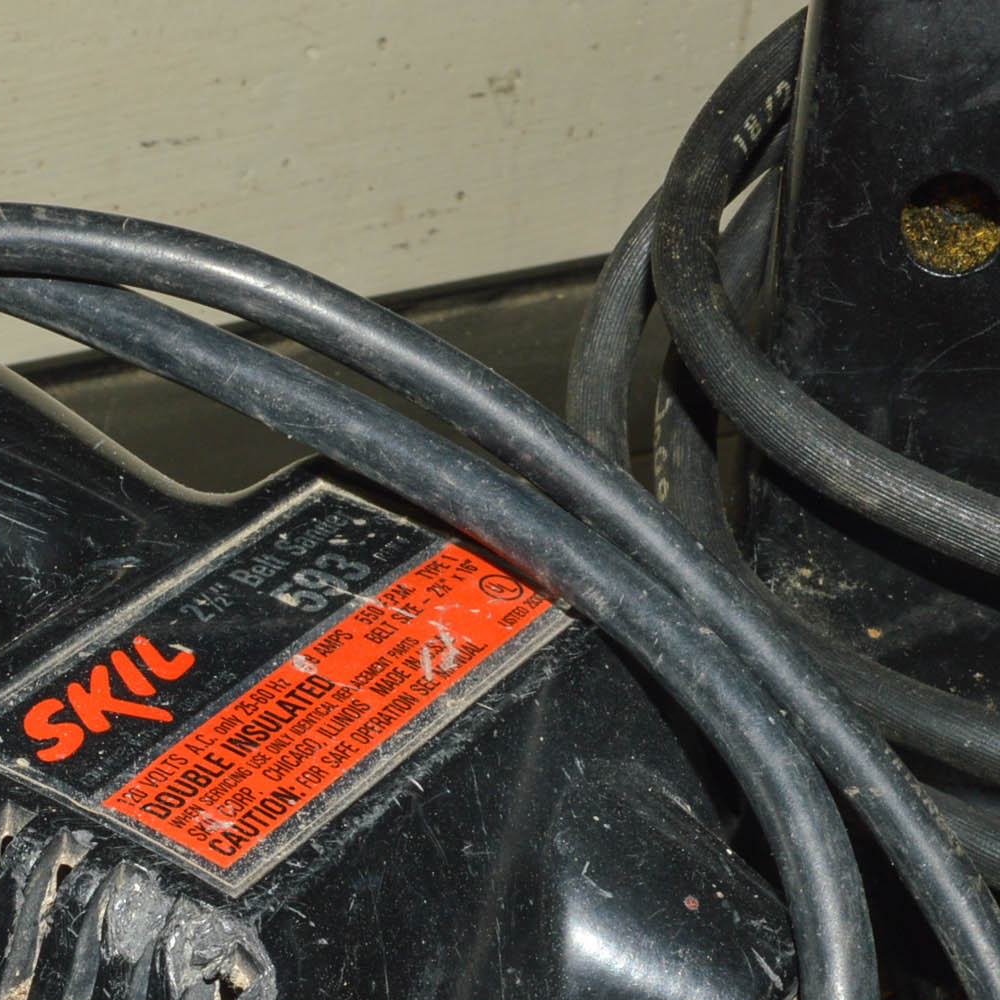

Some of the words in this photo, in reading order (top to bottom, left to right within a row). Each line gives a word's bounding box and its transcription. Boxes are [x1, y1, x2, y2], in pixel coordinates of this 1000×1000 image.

[229, 553, 290, 588] Belt
[273, 510, 350, 556] Sander
[270, 552, 370, 612] 593
[23, 635, 196, 762] SKIL
[114, 785, 150, 808] 120
[136, 752, 190, 789] VOLTS
[182, 730, 219, 755] A.C.
[209, 712, 246, 737] only
[233, 687, 276, 717] 25-60
[265, 675, 292, 693] Hz
[311, 627, 355, 658] AMPS
[353, 603, 387, 626] 550
[413, 556, 451, 582] TYPE
[363, 619, 401, 645] BELT
[138, 751, 236, 821] DOUBLE
[219, 672, 337, 758] INSULATED
[167, 802, 206, 829] WHEN
[197, 765, 254, 807] SERVICING
[245, 751, 273, 769] USE
[264, 732, 297, 755] ONLY
[288, 698, 340, 736] IDENTICAL
[385, 634, 421, 659] PARTS
[204, 781, 309, 857] CAUTION:
[294, 764, 331, 789] FOR
[318, 740, 361, 769] SAFE
[347, 691, 421, 745] OPERATION
[408, 673, 442, 697] SEE
[214, 783, 265, 818] CORP.
[259, 733, 329, 783] CHICAGO,
[314, 697, 373, 739] ILLINOIS
[368, 665, 413, 697] MADE
[400, 655, 426, 671] IN
